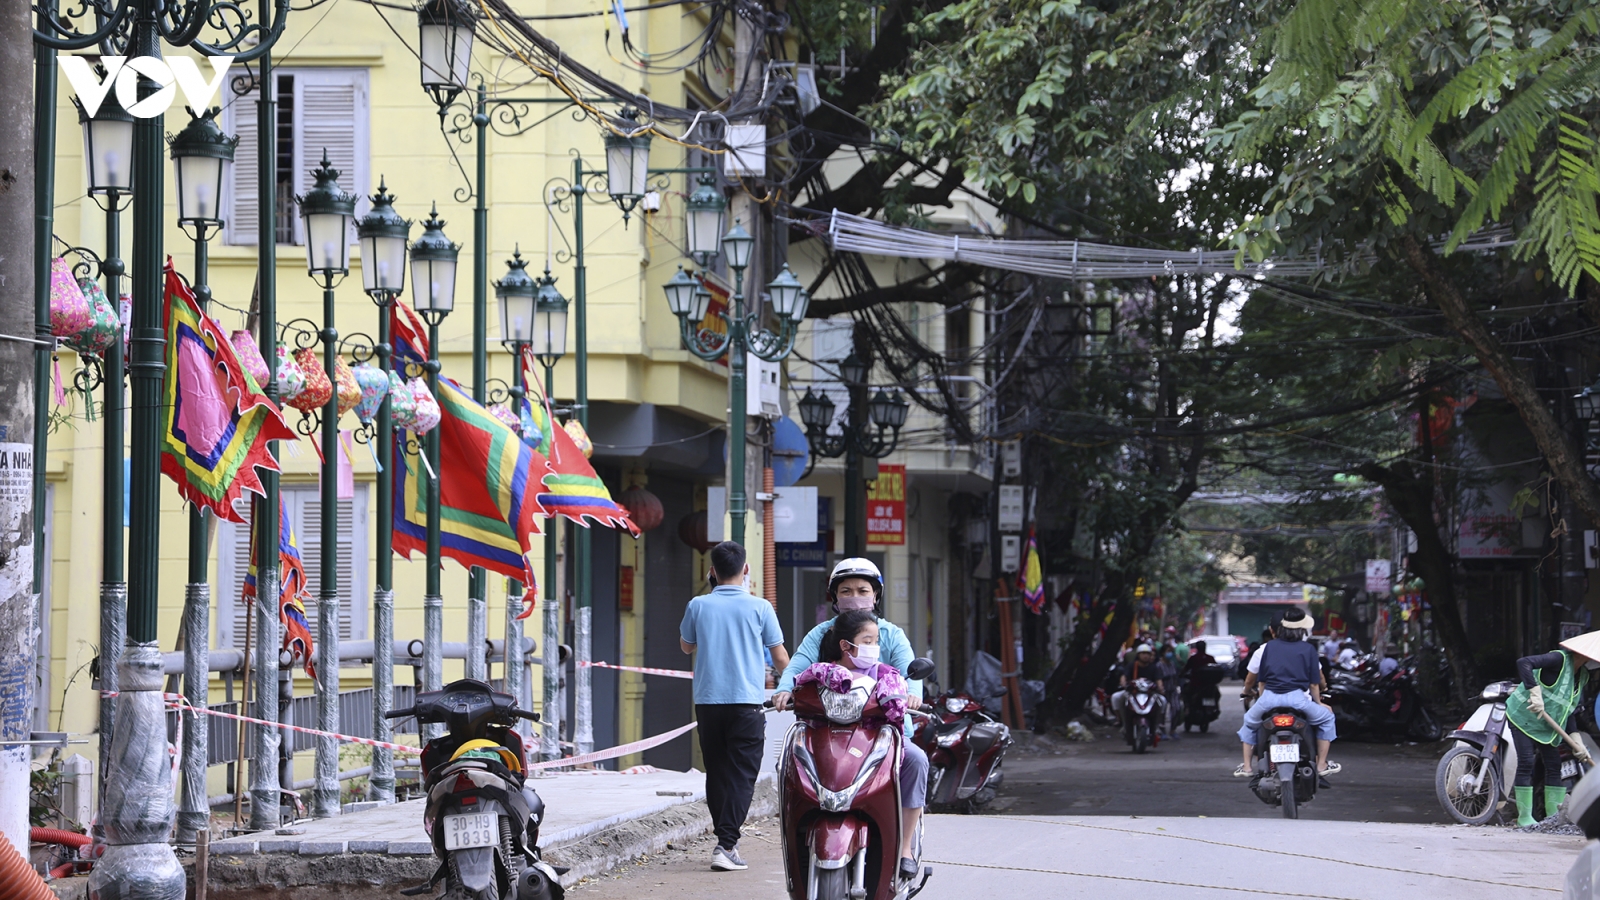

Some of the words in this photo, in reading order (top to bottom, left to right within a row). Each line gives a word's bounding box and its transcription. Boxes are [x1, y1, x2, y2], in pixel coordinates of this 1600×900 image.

[13, 449, 32, 469] NHÀ
[452, 815, 490, 831] 30-H9
[453, 830, 490, 846] 1839
